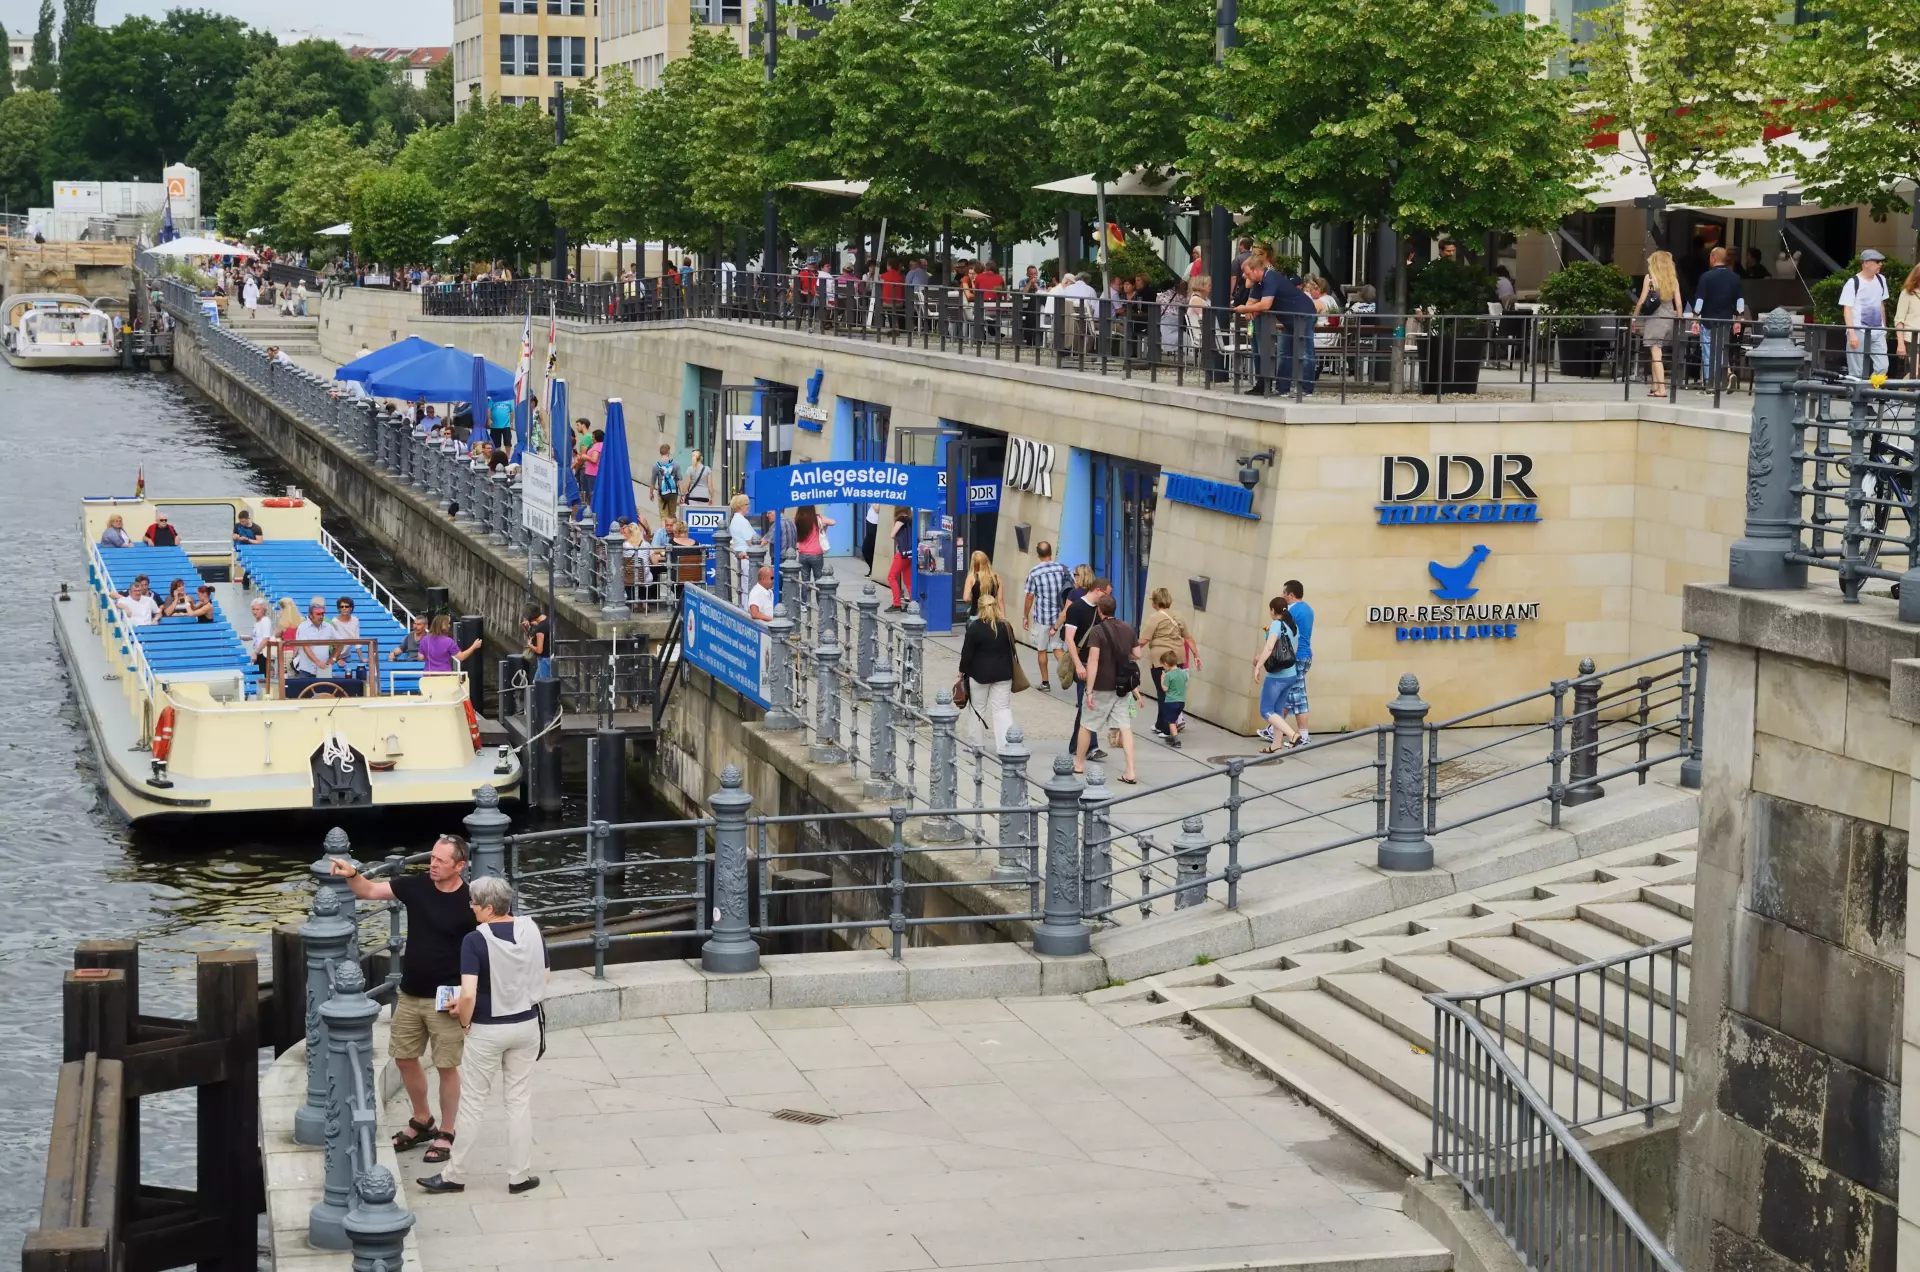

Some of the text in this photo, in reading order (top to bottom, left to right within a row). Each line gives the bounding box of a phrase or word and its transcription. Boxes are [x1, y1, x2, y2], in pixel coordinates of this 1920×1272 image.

[790, 467, 909, 487] Anlegestelle
[1005, 437, 1055, 498] DDR
[1380, 454, 1539, 502] DDR
[791, 487, 907, 501] Berliner Wassertaxi
[969, 486, 994, 499] DDR
[1161, 471, 1261, 520] museum
[692, 515, 719, 526] DDR
[1374, 503, 1543, 525] museum
[1367, 602, 1540, 623] DDR-RESTAURANT
[1396, 624, 1518, 641] DOMKLAUSE
